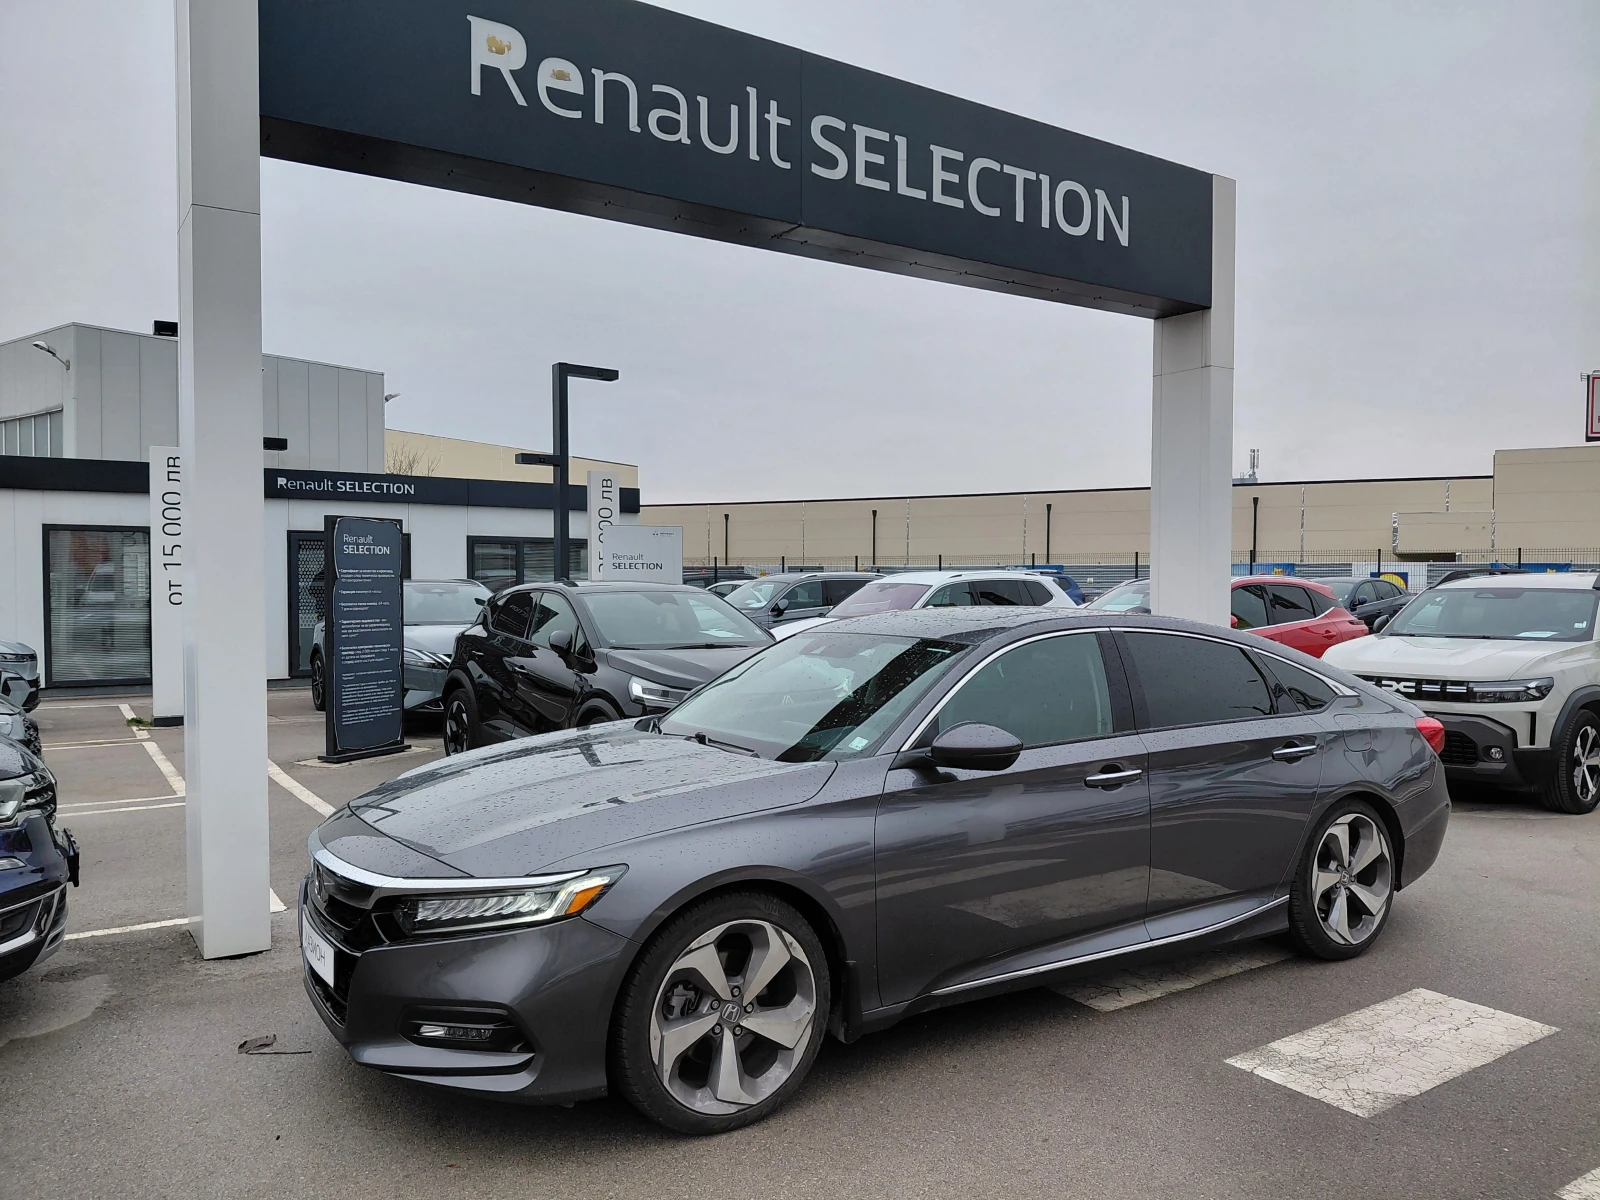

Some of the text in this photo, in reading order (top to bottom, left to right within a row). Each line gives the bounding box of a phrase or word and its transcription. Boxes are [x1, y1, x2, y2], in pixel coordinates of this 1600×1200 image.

[466, 14, 1129, 248] Renault SELECTION
[276, 476, 415, 495] Renault SELECTION
[161, 491, 182, 537] 000
[343, 533, 374, 544] Renault
[162, 544, 182, 571] 15
[343, 545, 390, 555] SELECTION
[612, 552, 644, 561] Renault
[612, 562, 663, 570] SELECTION
[168, 579, 183, 606] от
